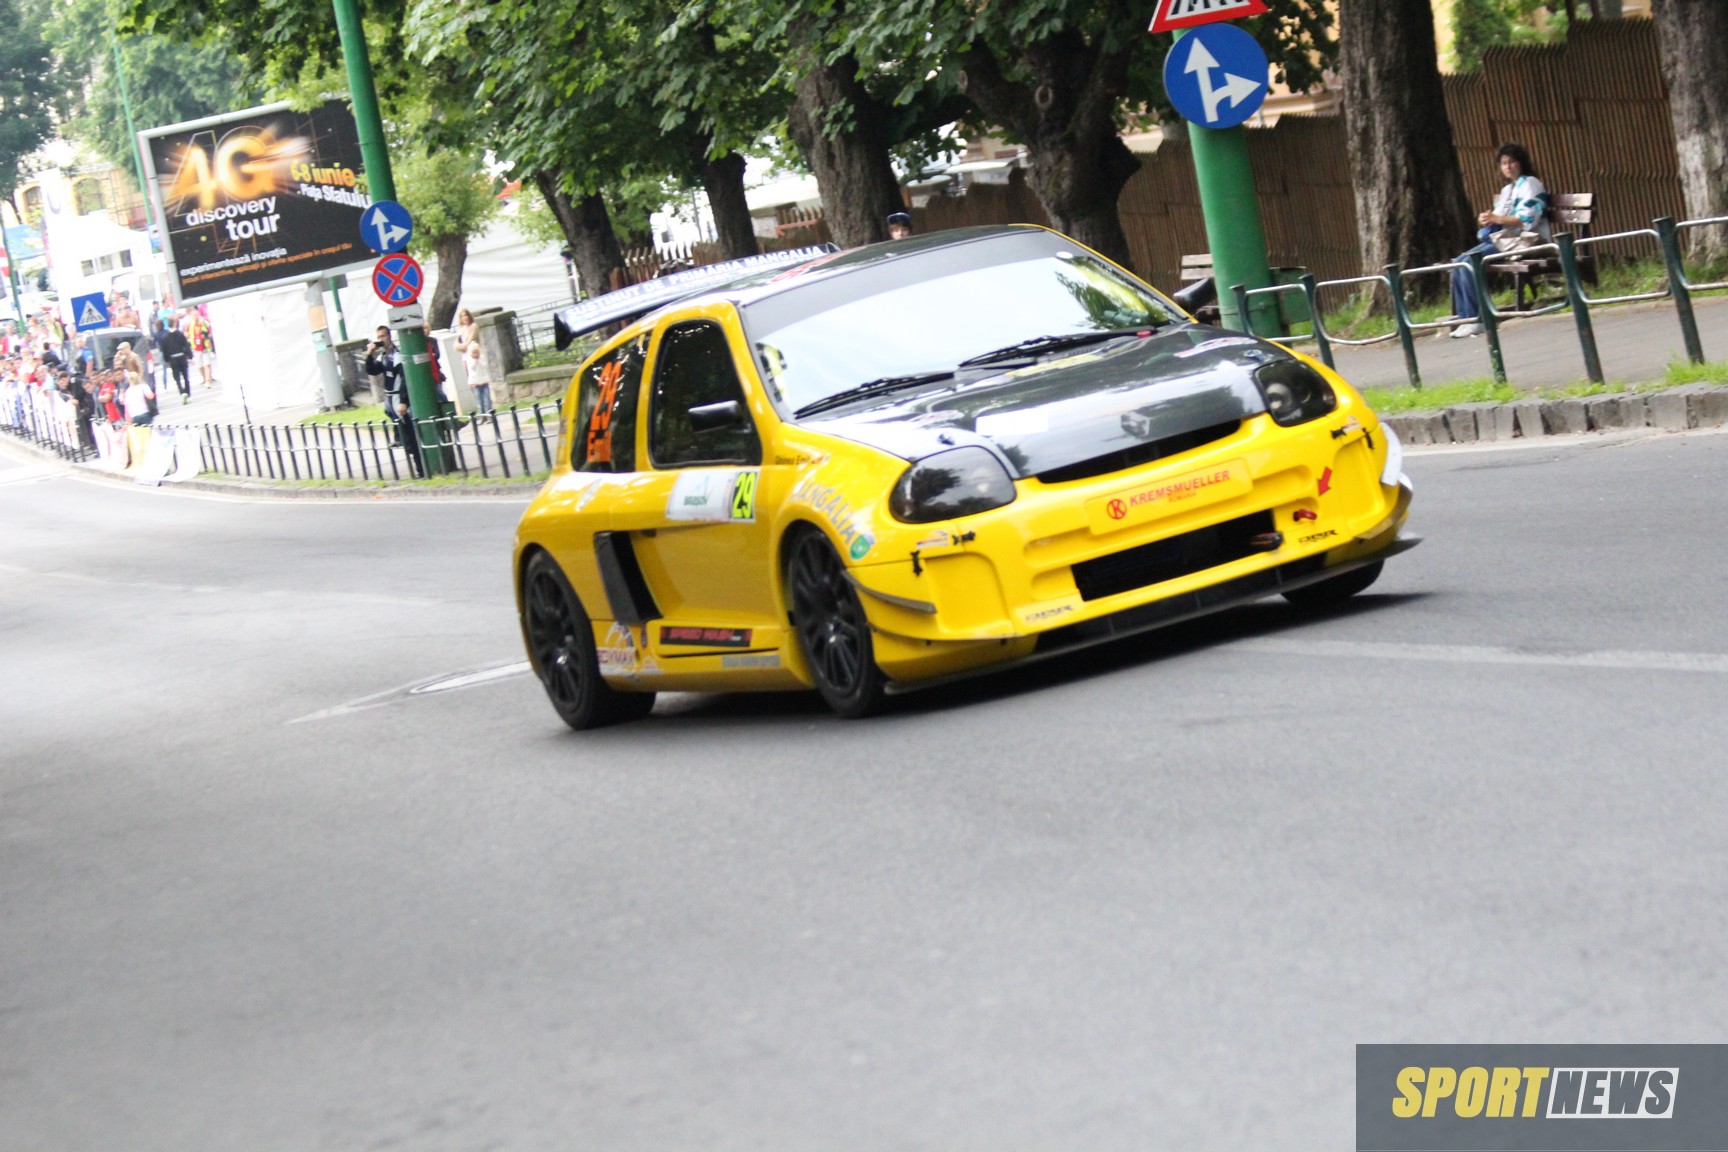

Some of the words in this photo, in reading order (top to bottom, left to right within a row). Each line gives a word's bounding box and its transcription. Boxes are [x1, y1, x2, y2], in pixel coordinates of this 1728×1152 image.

[310, 162, 356, 187] iunie
[186, 196, 277, 226] discovery
[226, 213, 280, 240] tour
[745, 246, 827, 268] MANGALIA
[732, 471, 757, 519] 29
[1129, 470, 1231, 507] KREMSMUELLER
